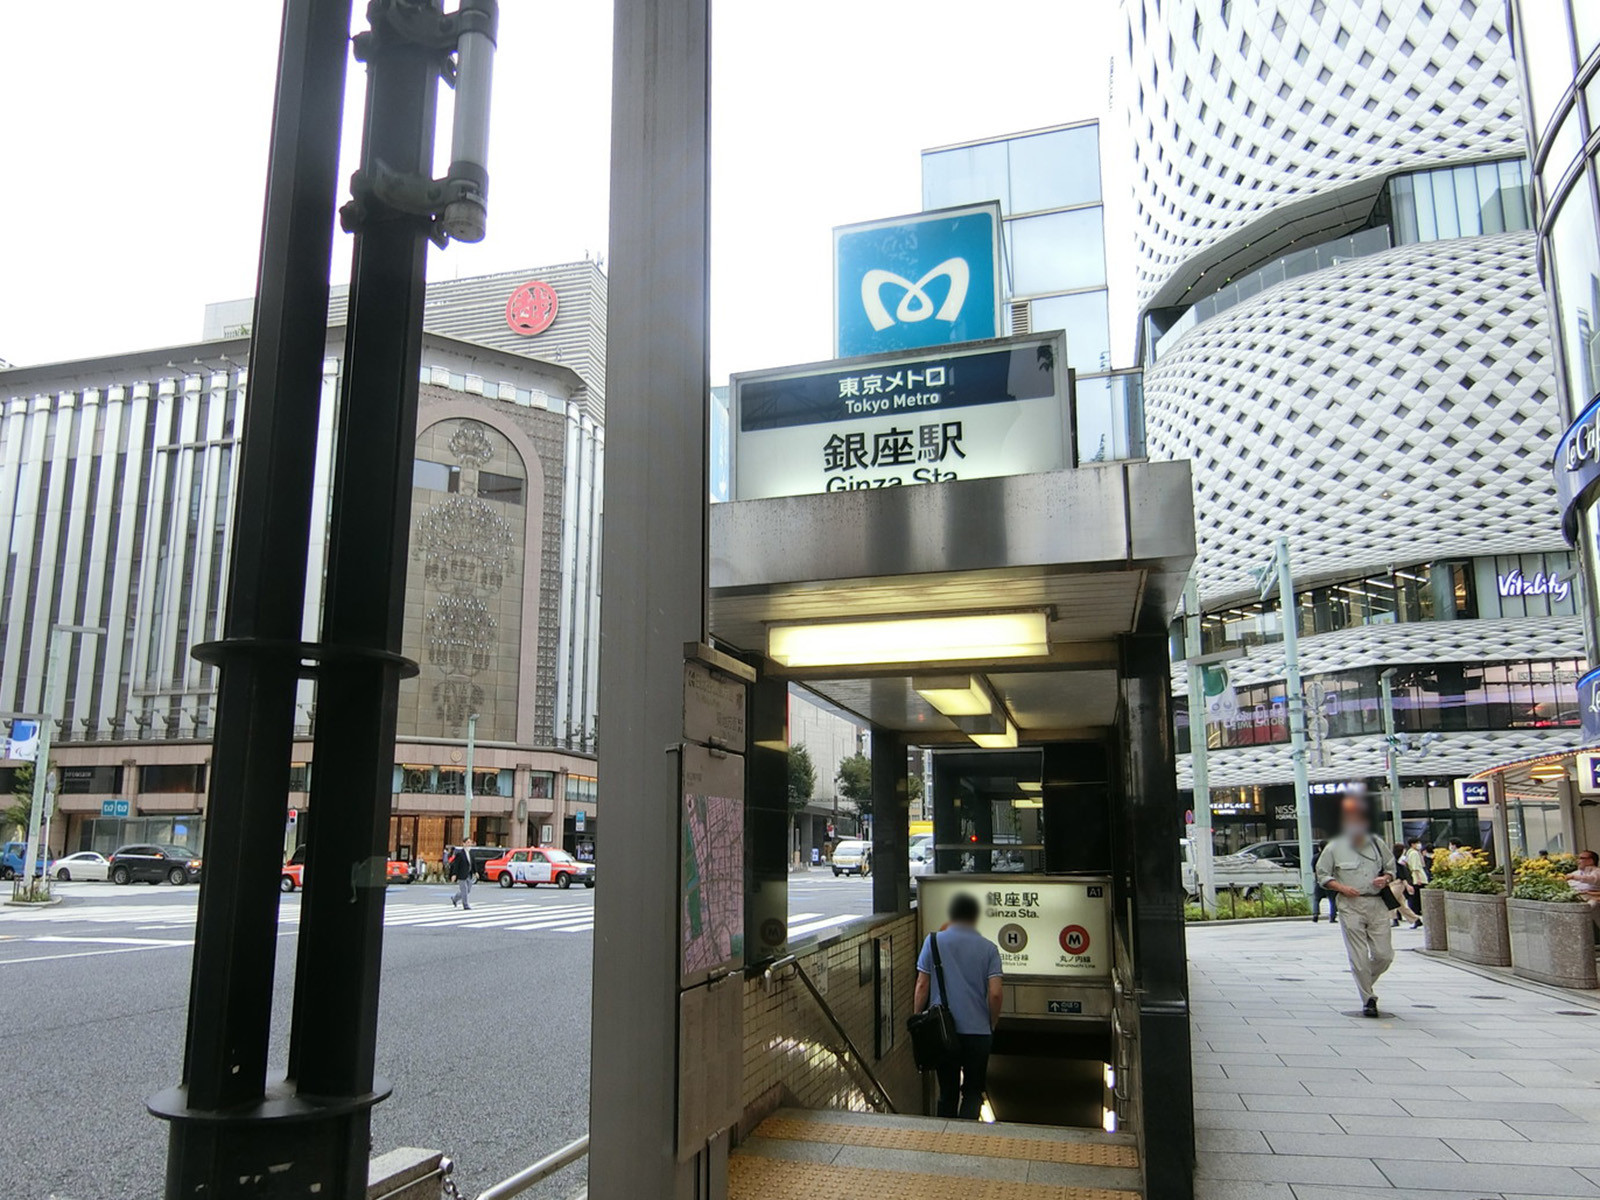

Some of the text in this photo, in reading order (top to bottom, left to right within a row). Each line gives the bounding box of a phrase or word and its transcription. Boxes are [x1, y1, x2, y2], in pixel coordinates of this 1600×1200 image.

[838, 366, 945, 399] 東京メトロ
[846, 391, 939, 415] Tokyo Metro
[823, 421, 967, 474] 銀座駅
[826, 472, 903, 492] Ginza
[1498, 568, 1571, 603] Vitality
[986, 892, 1040, 907] 銀座駅
[1089, 888, 1101, 897] A1
[986, 908, 1040, 918] Ginza Sta.
[1007, 933, 1018, 943] H
[1068, 934, 1081, 945] M
